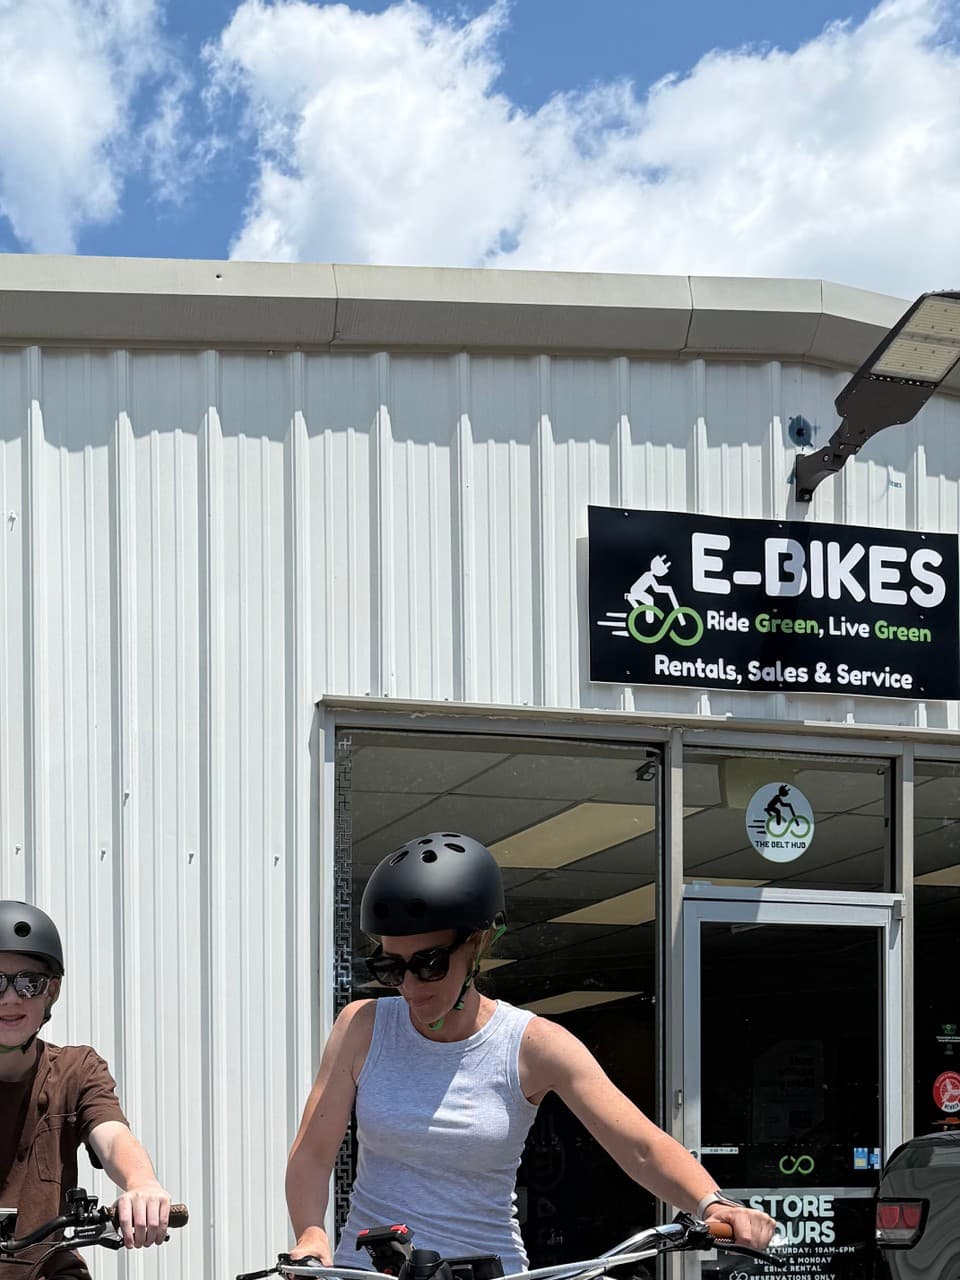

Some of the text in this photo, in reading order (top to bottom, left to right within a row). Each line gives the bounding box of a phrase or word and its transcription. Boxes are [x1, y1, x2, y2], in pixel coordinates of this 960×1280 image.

[691, 532, 946, 608] E-BIKES
[706, 611, 932, 643] Ride Green, Live Green
[654, 655, 913, 689] Rentals, Sales & Service
[754, 840, 807, 849] THE BELT HUB
[749, 1195, 835, 1217] STORE
[775, 1221, 836, 1244] OURS
[790, 1265, 822, 1273] RENTAL
[814, 1273, 836, 1280] ONLY
